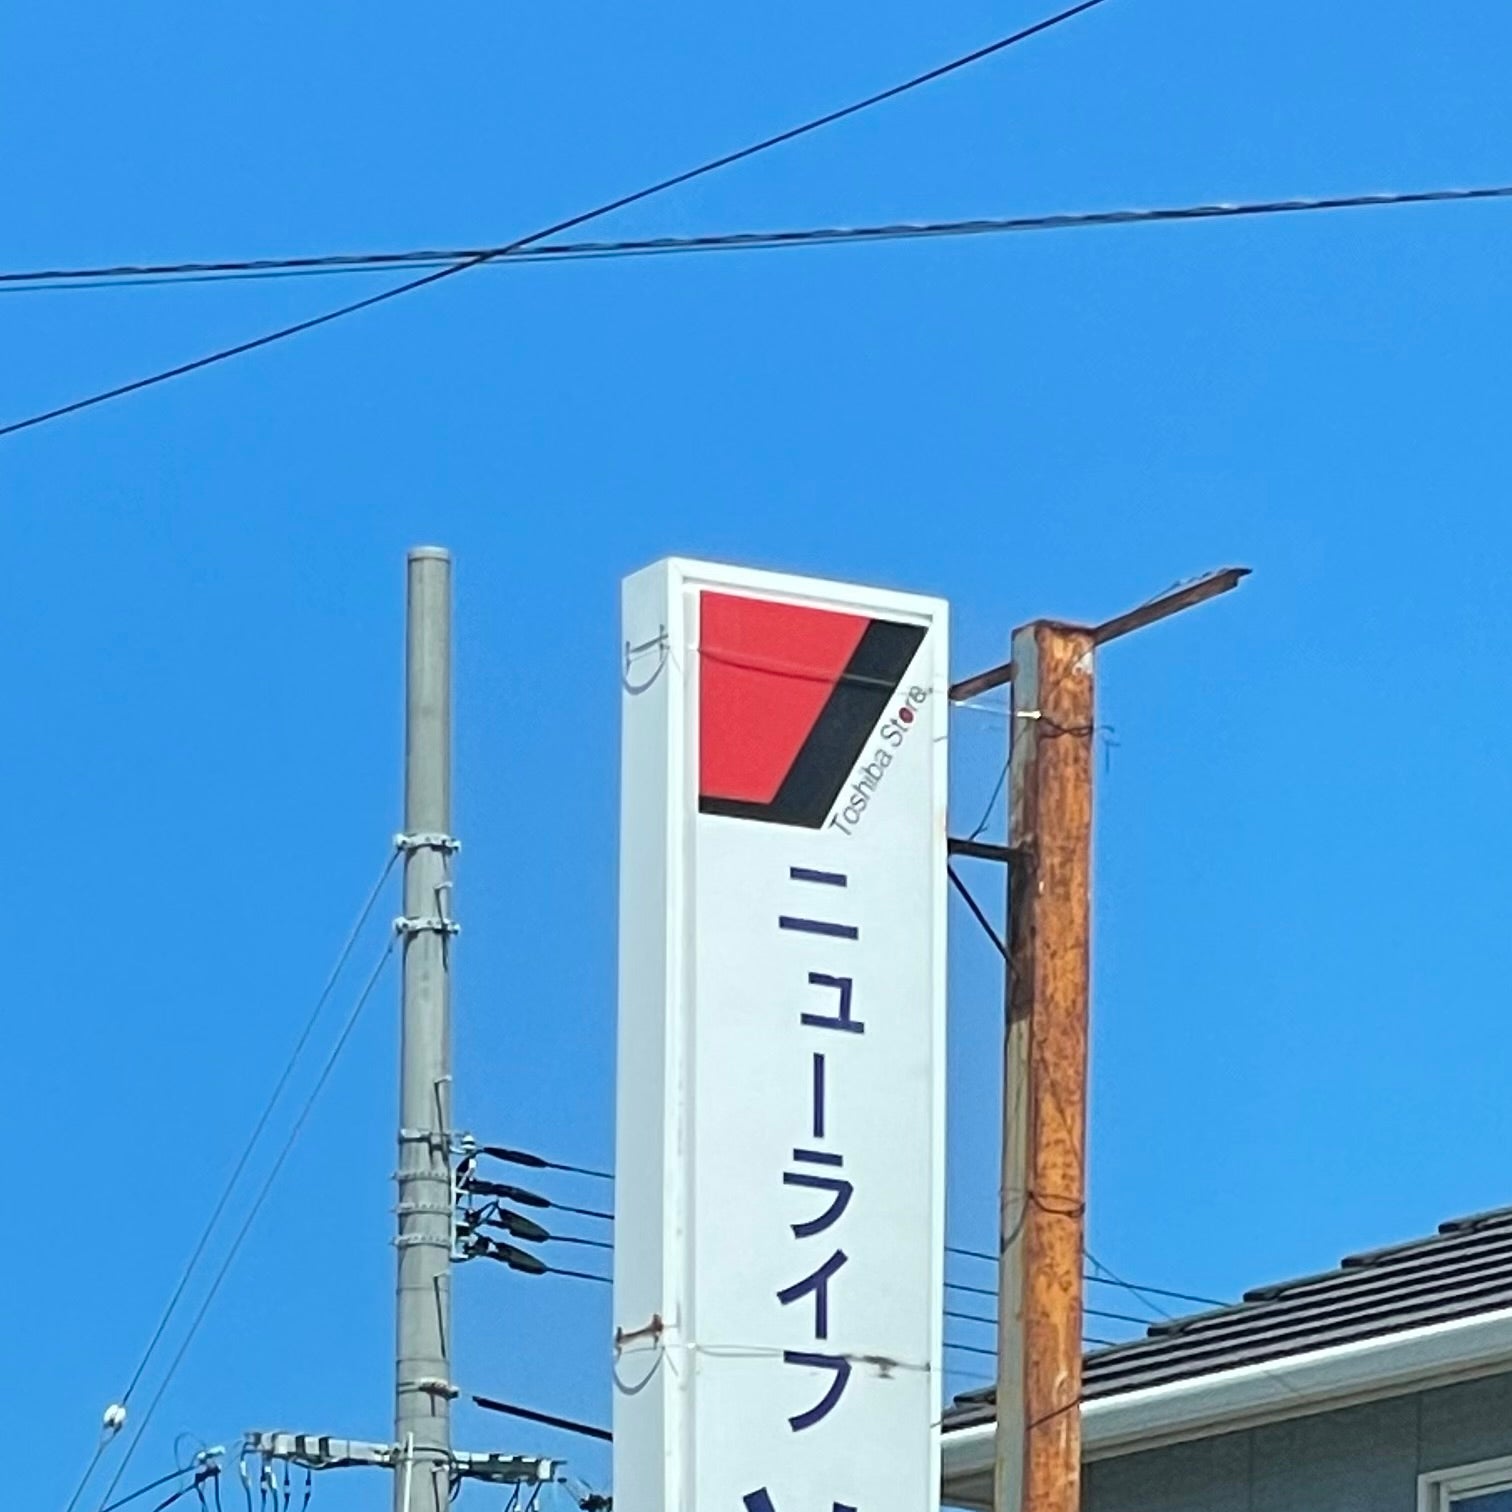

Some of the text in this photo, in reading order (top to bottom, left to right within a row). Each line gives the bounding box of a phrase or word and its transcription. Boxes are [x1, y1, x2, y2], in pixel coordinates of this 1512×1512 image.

[829, 748, 893, 836] Toshiba
[777, 866, 865, 1432] ニューライフ
